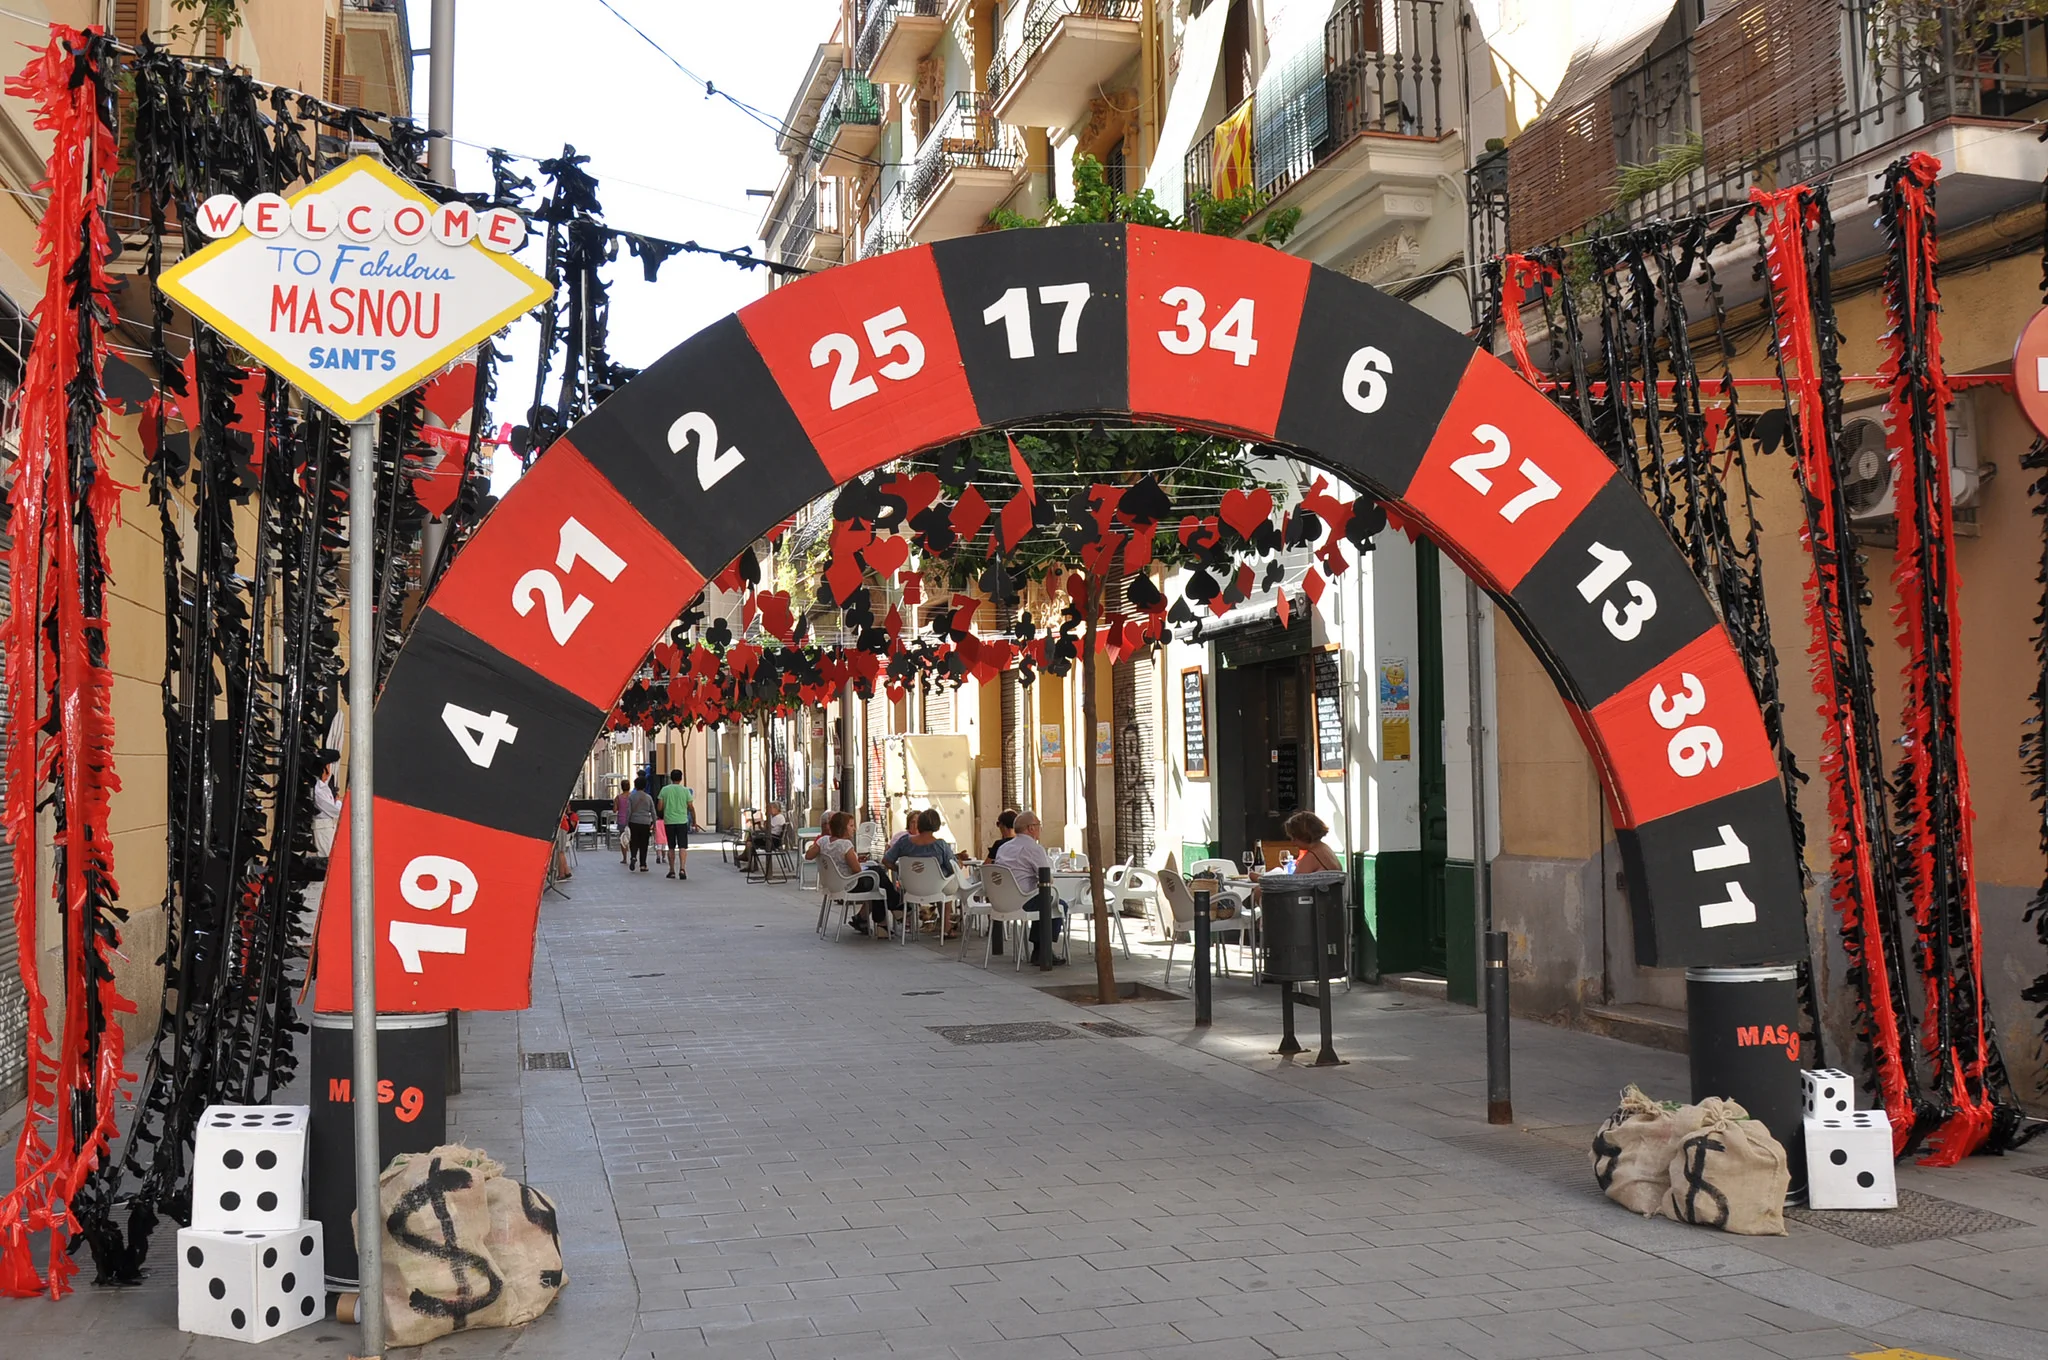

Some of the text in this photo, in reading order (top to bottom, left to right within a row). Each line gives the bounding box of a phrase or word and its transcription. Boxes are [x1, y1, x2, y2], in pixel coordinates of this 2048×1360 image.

[204, 202, 516, 244] WELCOME
[267, 243, 456, 284] TO Fabulous
[269, 284, 441, 339] MASNOU
[983, 283, 1090, 358] 17
[1158, 287, 1258, 367] 34
[308, 346, 397, 372] SANTS
[809, 306, 926, 411] 25
[1342, 346, 1393, 414] 6
[667, 411, 746, 491] 2
[1449, 424, 1562, 524] 27
[511, 516, 628, 647] 21
[1576, 541, 1658, 642] 13
[441, 702, 519, 769] 4
[1648, 672, 1724, 777] 36
[388, 855, 479, 974] 19
[1692, 825, 1757, 929] 11
[329, 1078, 425, 1123] MS9
